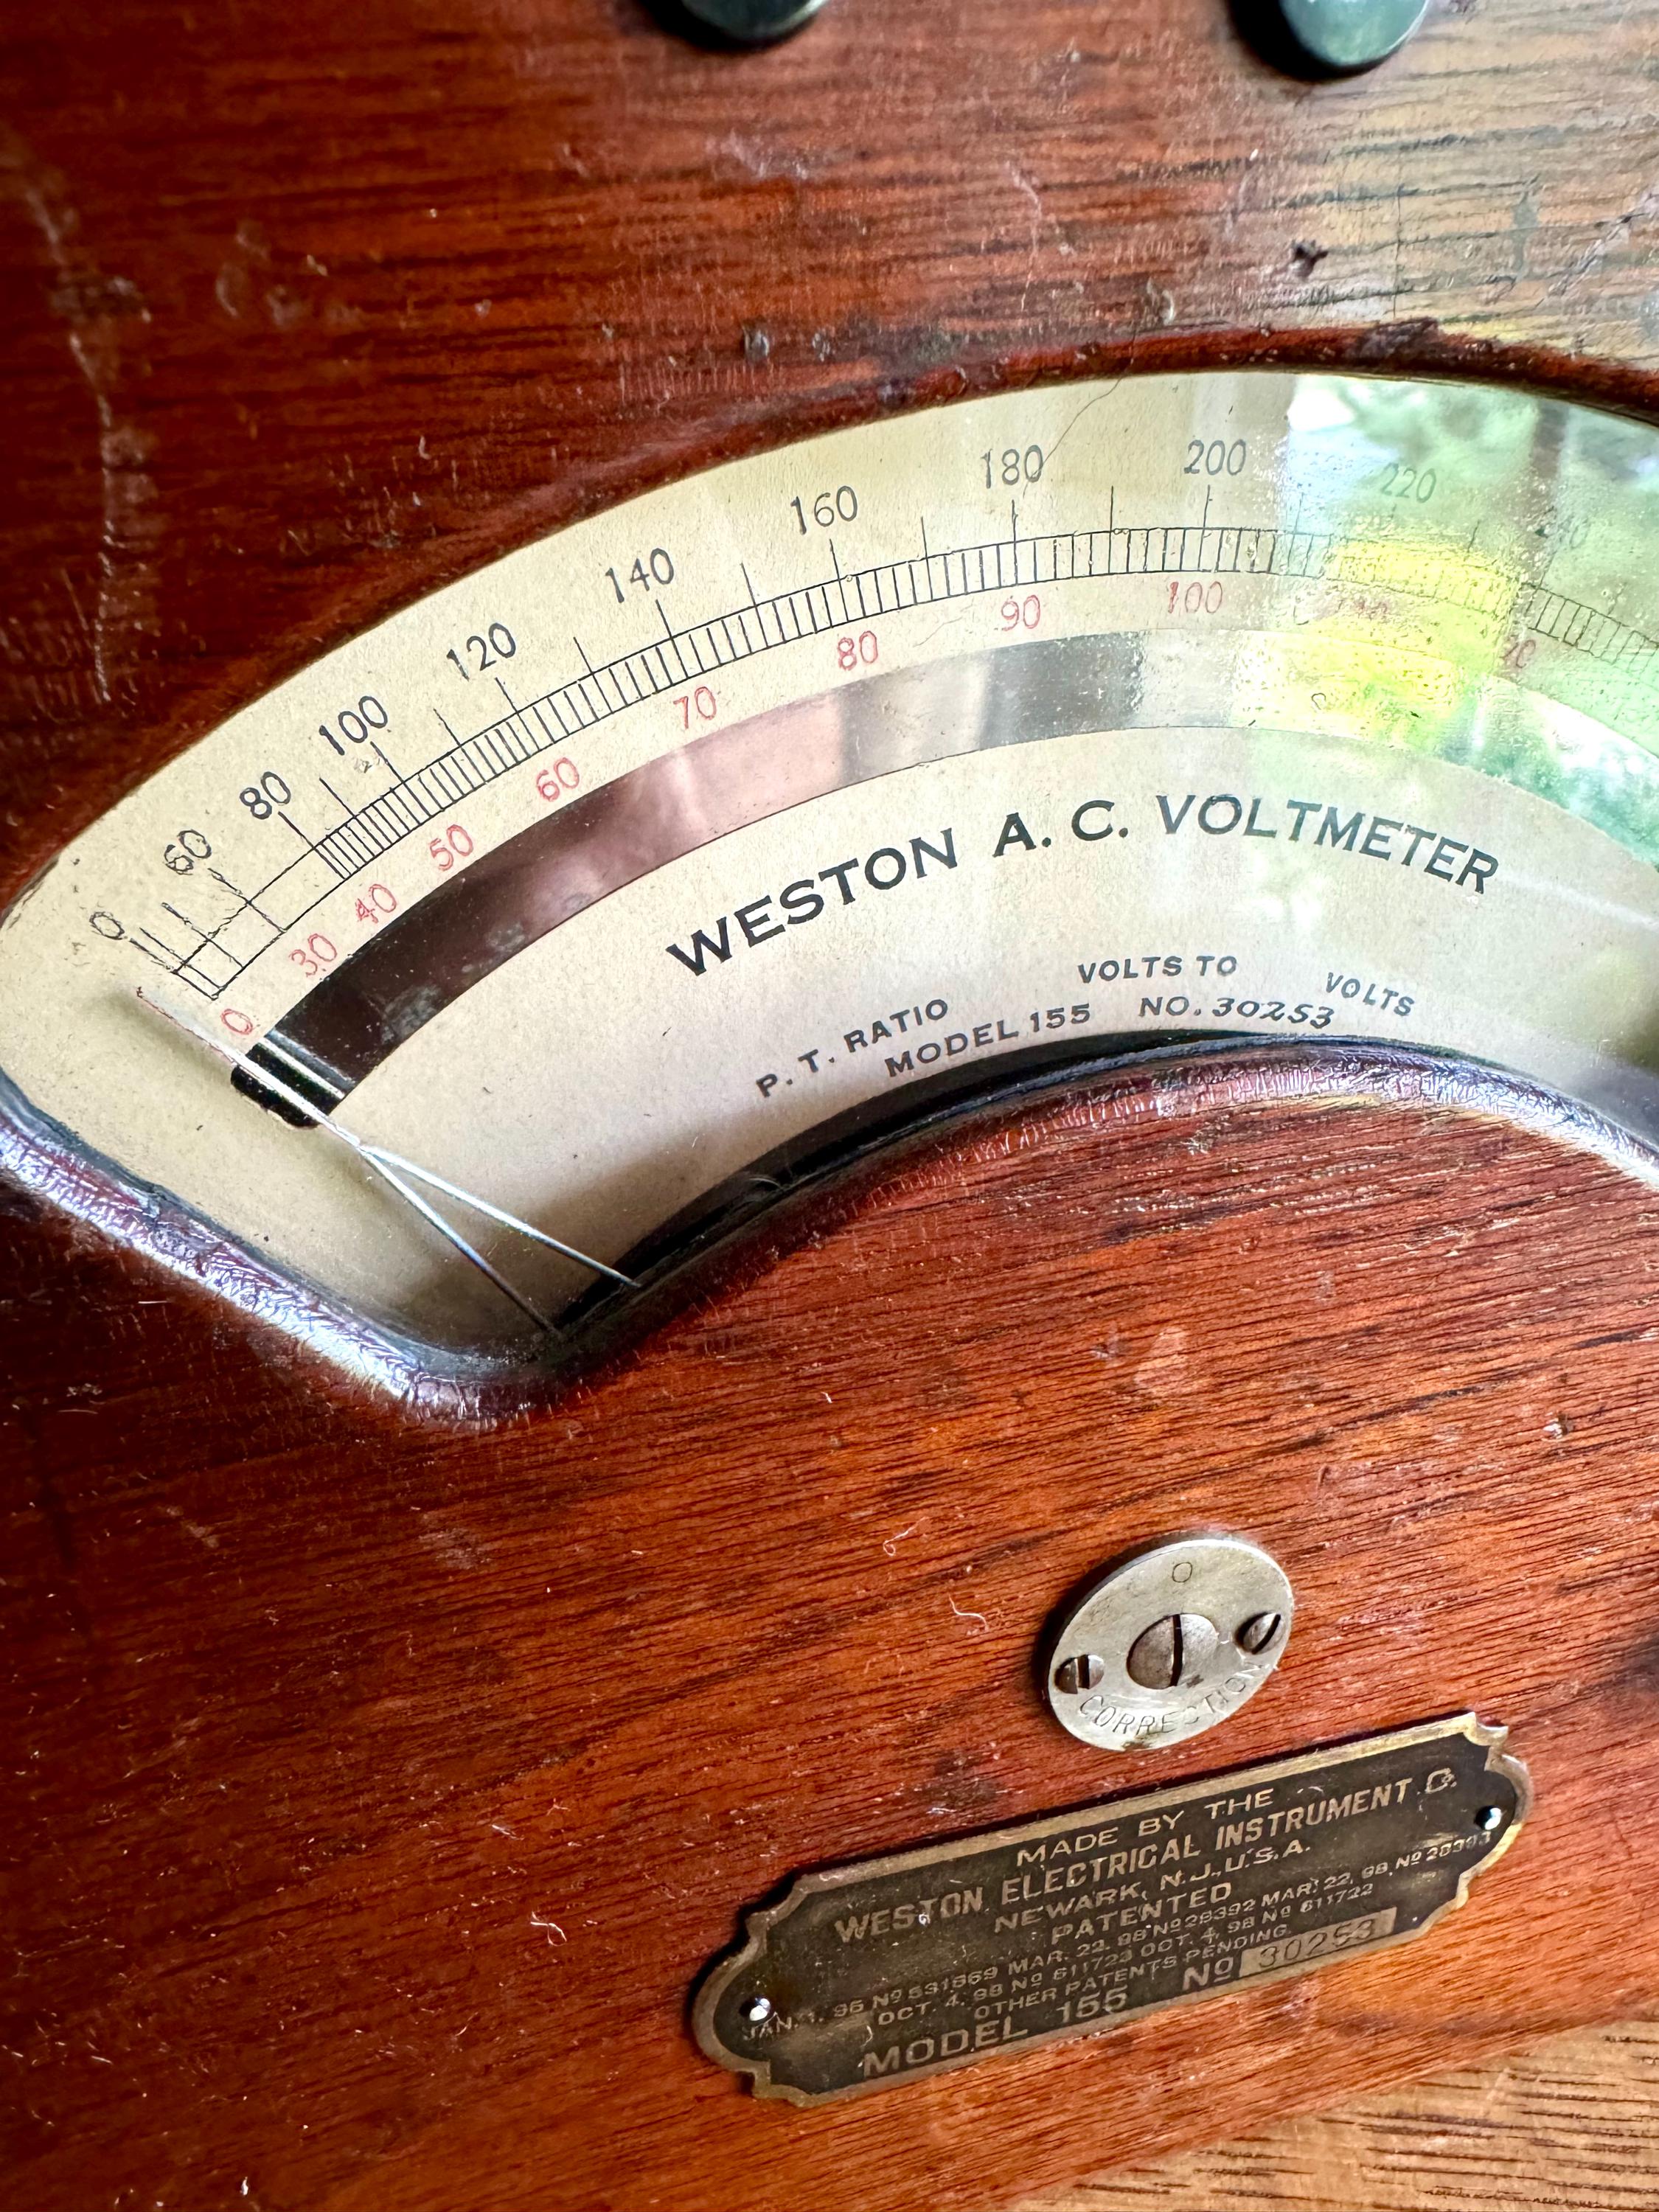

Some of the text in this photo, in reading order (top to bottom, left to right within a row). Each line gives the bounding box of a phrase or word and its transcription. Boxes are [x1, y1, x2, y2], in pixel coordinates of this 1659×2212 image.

[88, 439, 1436, 939] 0 60 80 100 120 140 160 180 200 220
[221, 582, 1222, 1034] 0 30 40 50 60 70 80 90 100
[665, 827, 958, 976] WESTON
[1156, 795, 1498, 894] VOLTMETER
[844, 999, 948, 1053] RATIO
[1078, 956, 1182, 984] VOLTS
[1196, 956, 1237, 976] TO
[1327, 972, 1414, 1016] VOLTS
[885, 997, 1334, 1077] MODEL 155 NO. 30253
[835, 1887, 983, 1943] WESTON
[1001, 1834, 1200, 1905] ELECTRICAL
[1215, 1778, 1413, 1850] INSTRUMENT
[1017, 1788, 1274, 1867] MADE BY THE
[995, 1882, 1147, 1933] NEWARK,
[1051, 1882, 1231, 1945] PATENTED
[863, 2015, 1029, 2079] MODEL
[1056, 1985, 1128, 2023] 155
[1259, 1918, 1374, 1969] 30253
[974, 1987, 1057, 2020] OTHER
[1065, 1955, 1177, 1996] PATENTS
[1008, 1950, 1069, 1975] MAR.
